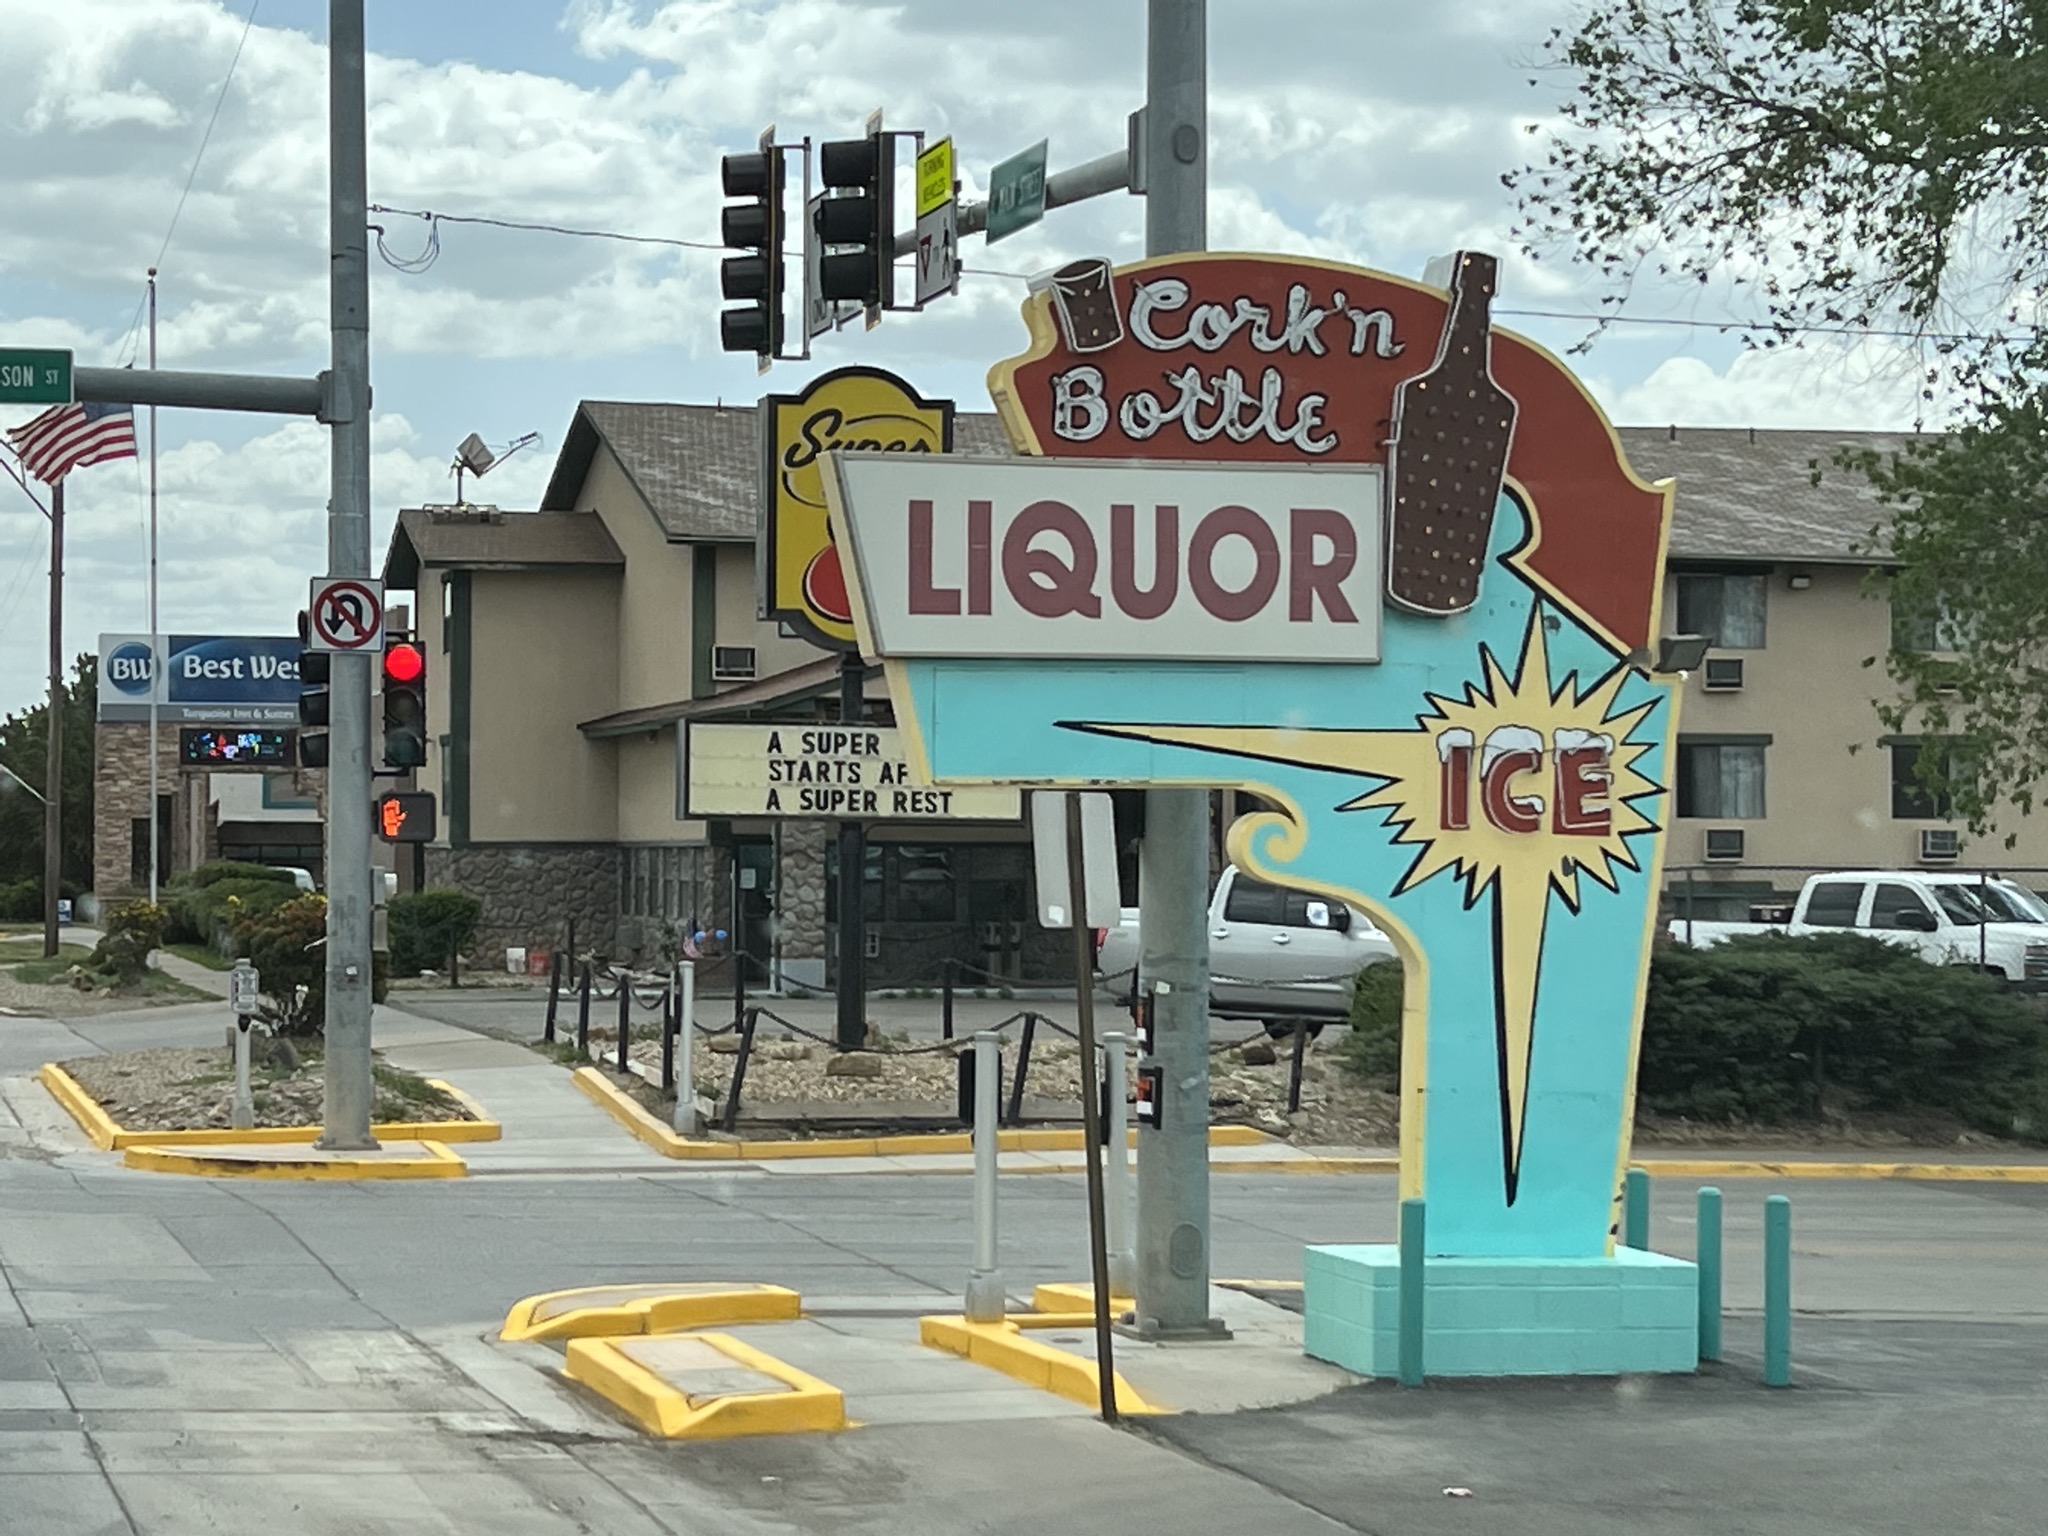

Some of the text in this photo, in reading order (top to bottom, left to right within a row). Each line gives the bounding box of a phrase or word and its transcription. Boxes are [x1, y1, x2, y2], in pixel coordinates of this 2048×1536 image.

[0, 365, 59, 387] SON ST
[1052, 365, 1338, 453] Bottle
[908, 500, 1359, 623] LIQUOR
[113, 658, 153, 680] BW
[184, 655, 244, 679] Best
[767, 731, 880, 755] A SUPER
[769, 760, 861, 784] STARTS
[1437, 726, 1615, 836] ICE
[766, 788, 953, 813] A SUPER REST
